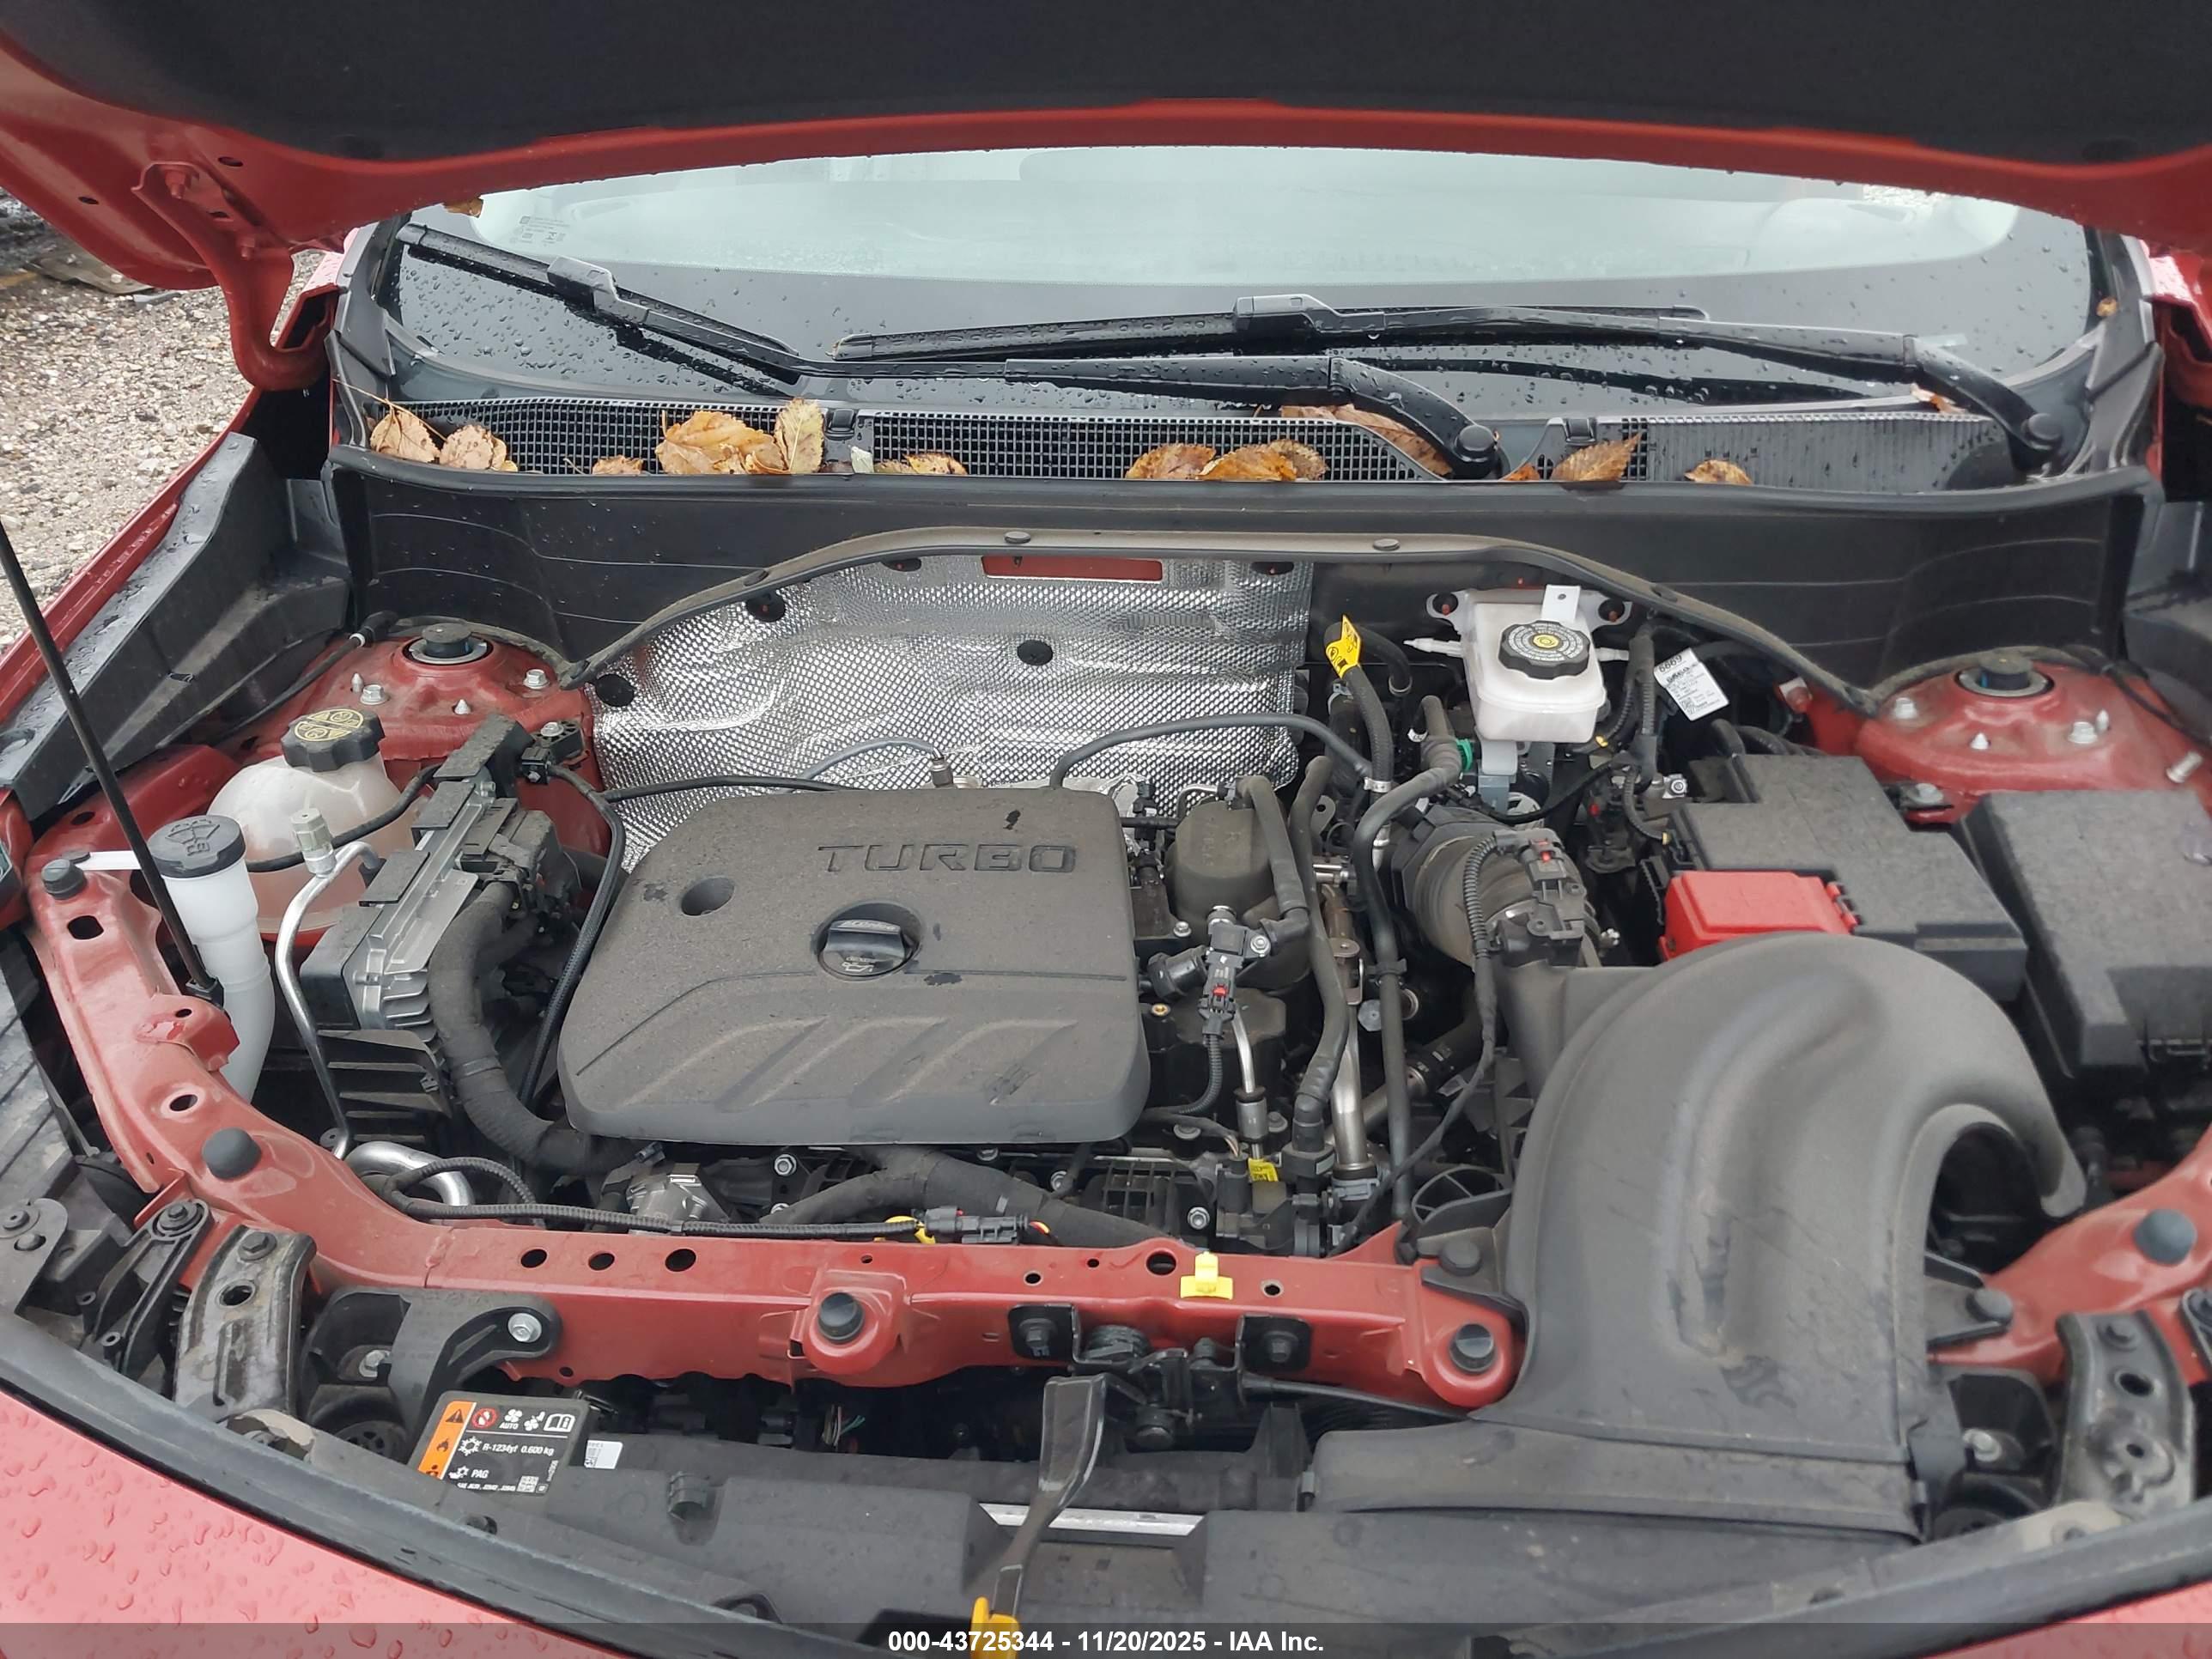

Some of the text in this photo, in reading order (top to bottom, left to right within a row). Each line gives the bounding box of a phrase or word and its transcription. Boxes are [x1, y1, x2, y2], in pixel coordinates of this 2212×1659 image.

[817, 844, 1076, 873] TURBO
[482, 1443, 555, 1457] R-1234yf 0.600 kg
[471, 1469, 489, 1479] PAG
